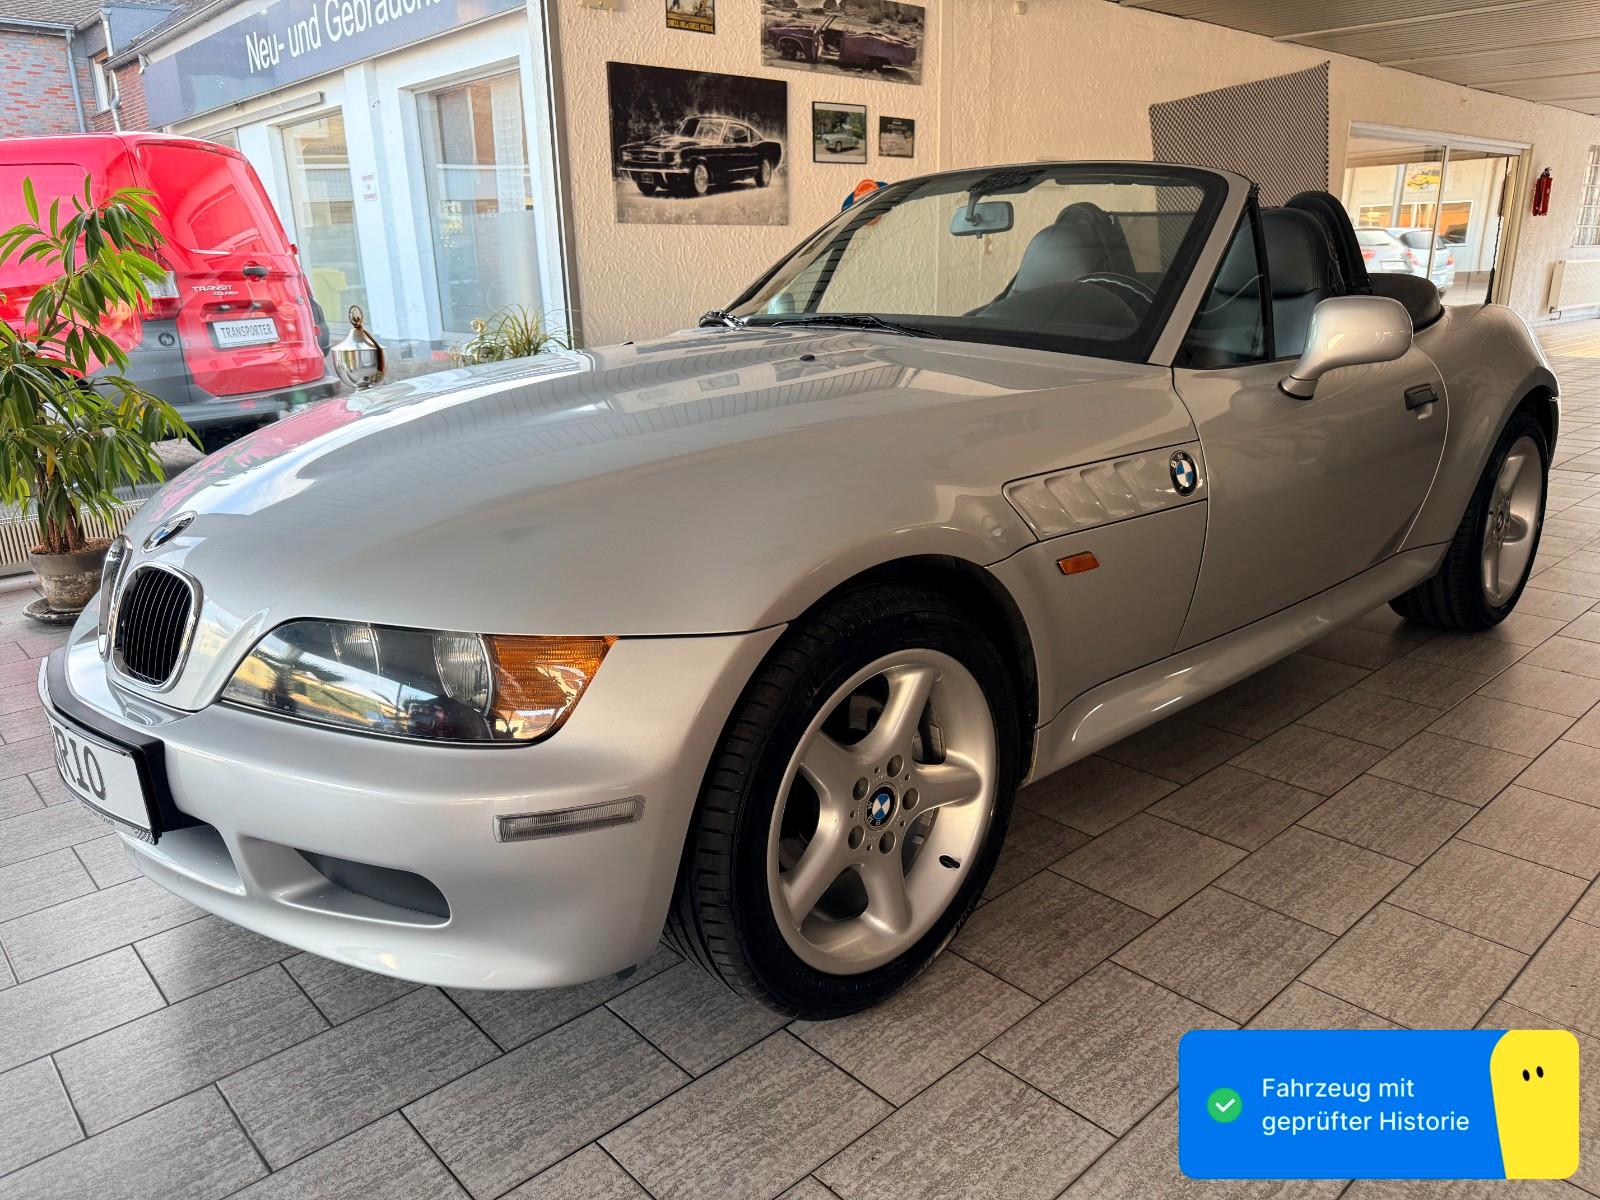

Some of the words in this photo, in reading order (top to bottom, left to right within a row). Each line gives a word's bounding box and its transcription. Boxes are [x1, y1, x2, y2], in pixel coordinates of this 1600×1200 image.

[245, 31, 285, 74] Neu-
[287, 10, 322, 58] und
[324, 0, 442, 42] Gebrau
[191, 284, 233, 293] TRANSIT
[220, 323, 274, 339] TRANSPORTER
[52, 724, 107, 801] RIO
